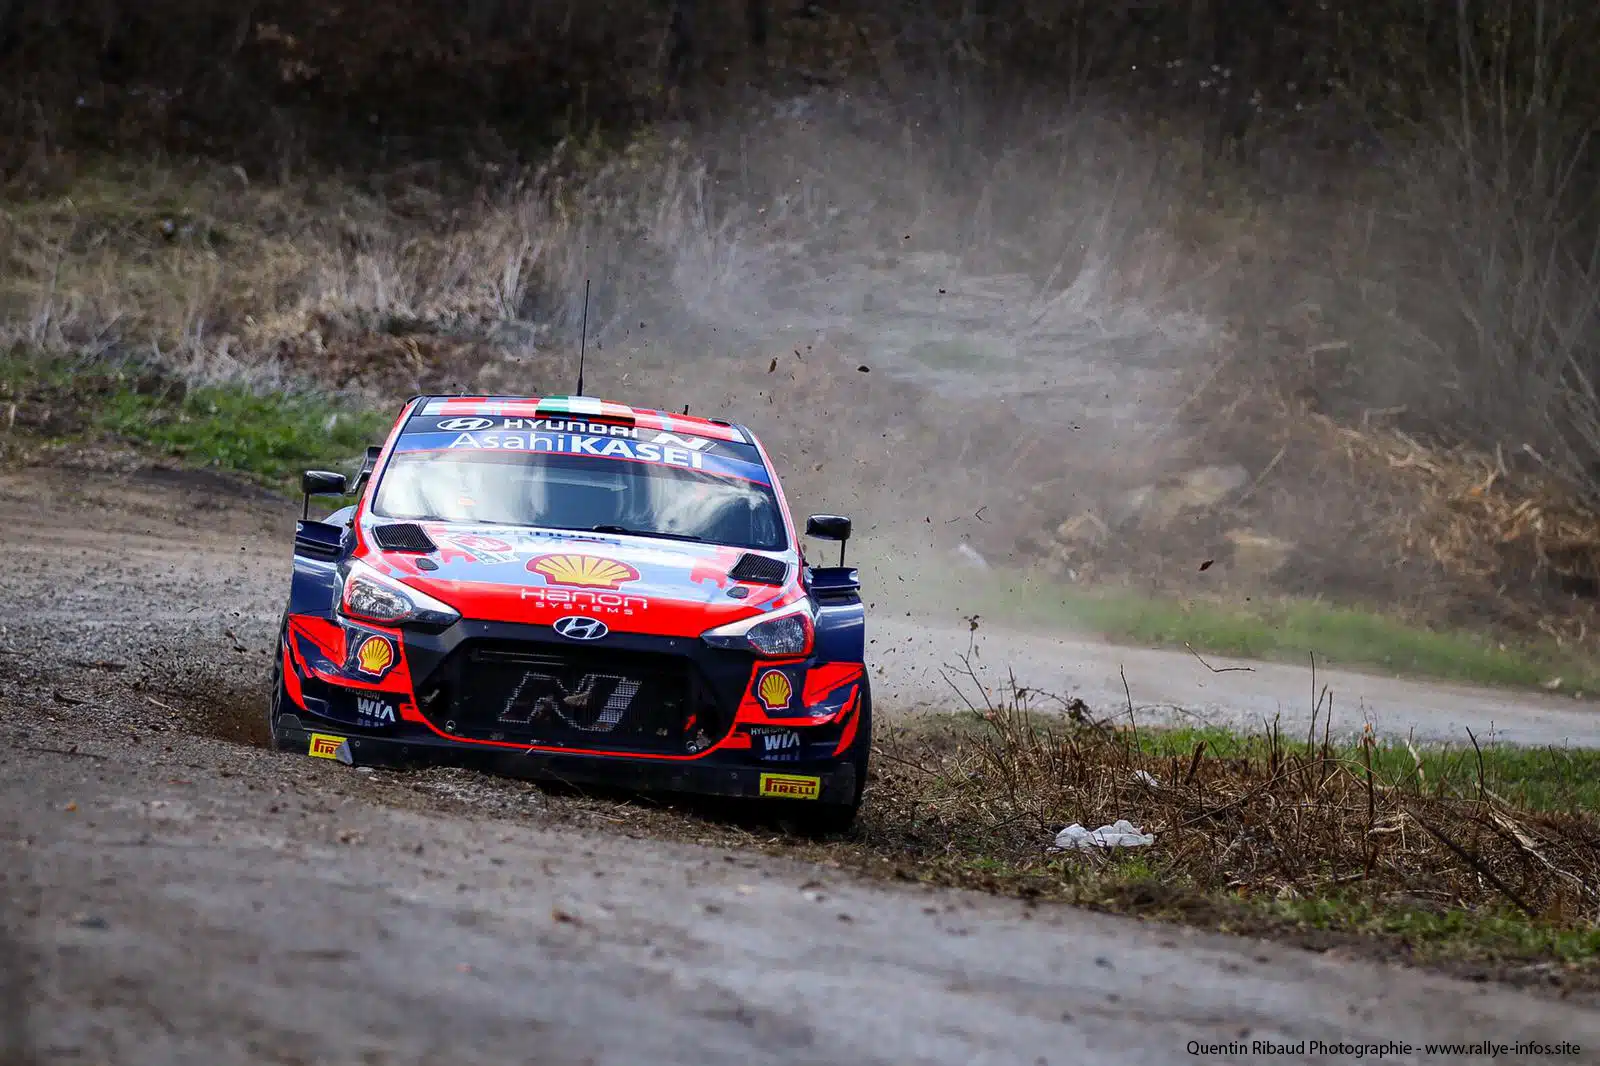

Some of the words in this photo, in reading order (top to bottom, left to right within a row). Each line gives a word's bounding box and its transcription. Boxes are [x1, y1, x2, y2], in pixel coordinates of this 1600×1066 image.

[503, 418, 638, 438] HYUNDAI
[520, 588, 648, 609] Hanon
[535, 601, 633, 616] SYSTEMS
[357, 697, 396, 722] WIA
[764, 732, 800, 750] WIA
[765, 777, 816, 794] PIRELLI
